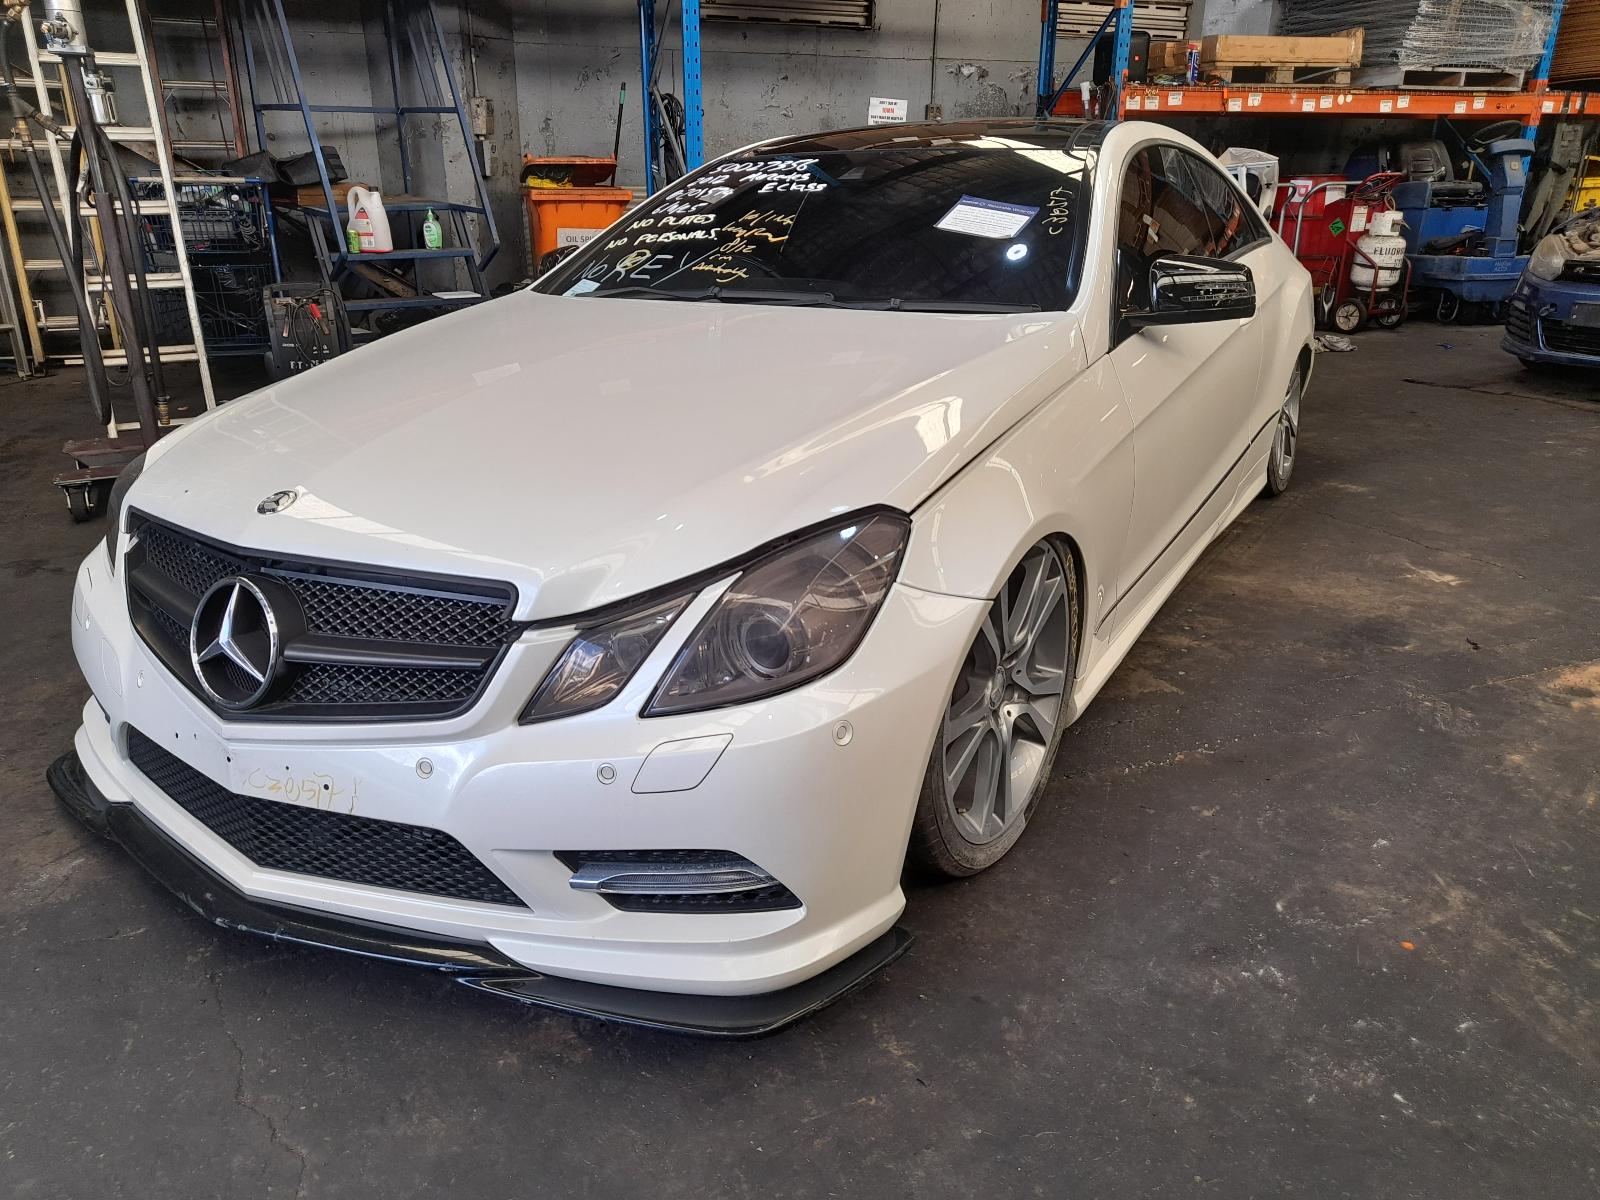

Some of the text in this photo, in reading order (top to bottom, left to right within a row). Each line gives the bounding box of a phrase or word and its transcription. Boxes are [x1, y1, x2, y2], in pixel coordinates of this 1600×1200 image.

[624, 218, 655, 233] NO
[565, 235, 579, 243] OIL
[603, 237, 628, 251] NO
